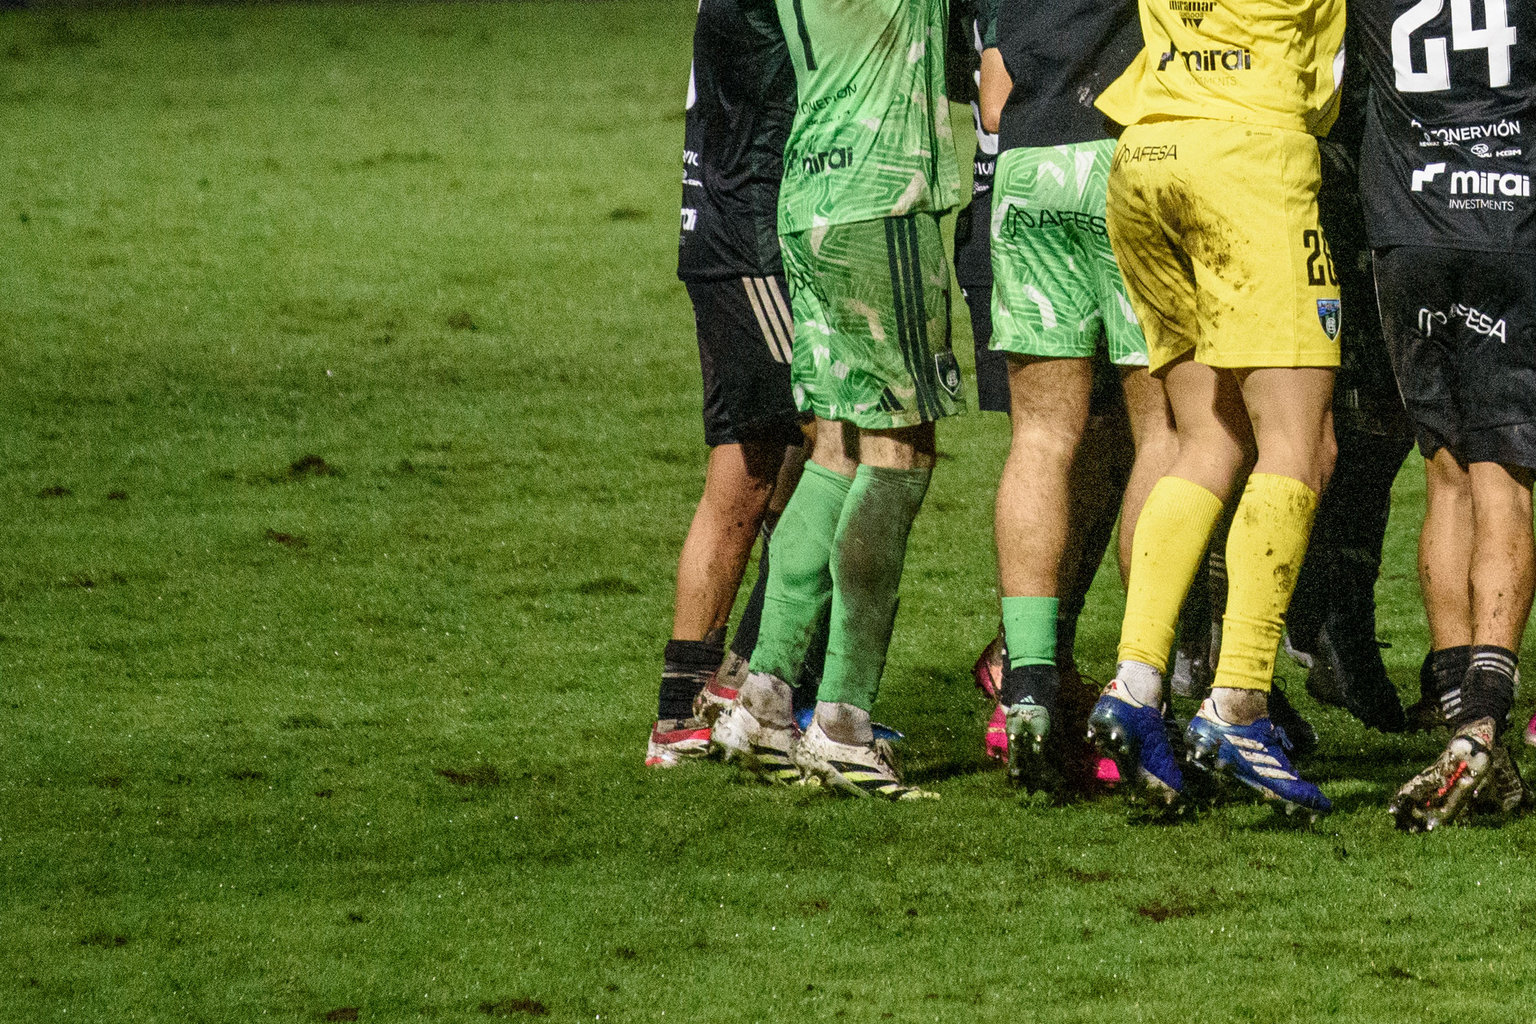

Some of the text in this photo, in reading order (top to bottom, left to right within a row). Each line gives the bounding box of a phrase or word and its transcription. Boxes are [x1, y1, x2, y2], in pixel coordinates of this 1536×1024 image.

[1130, 144, 1178, 163] AFESA
[1450, 170, 1531, 198] mirai
[1448, 199, 1515, 213] INVESTMENTS
[1039, 209, 1108, 236] AFES
